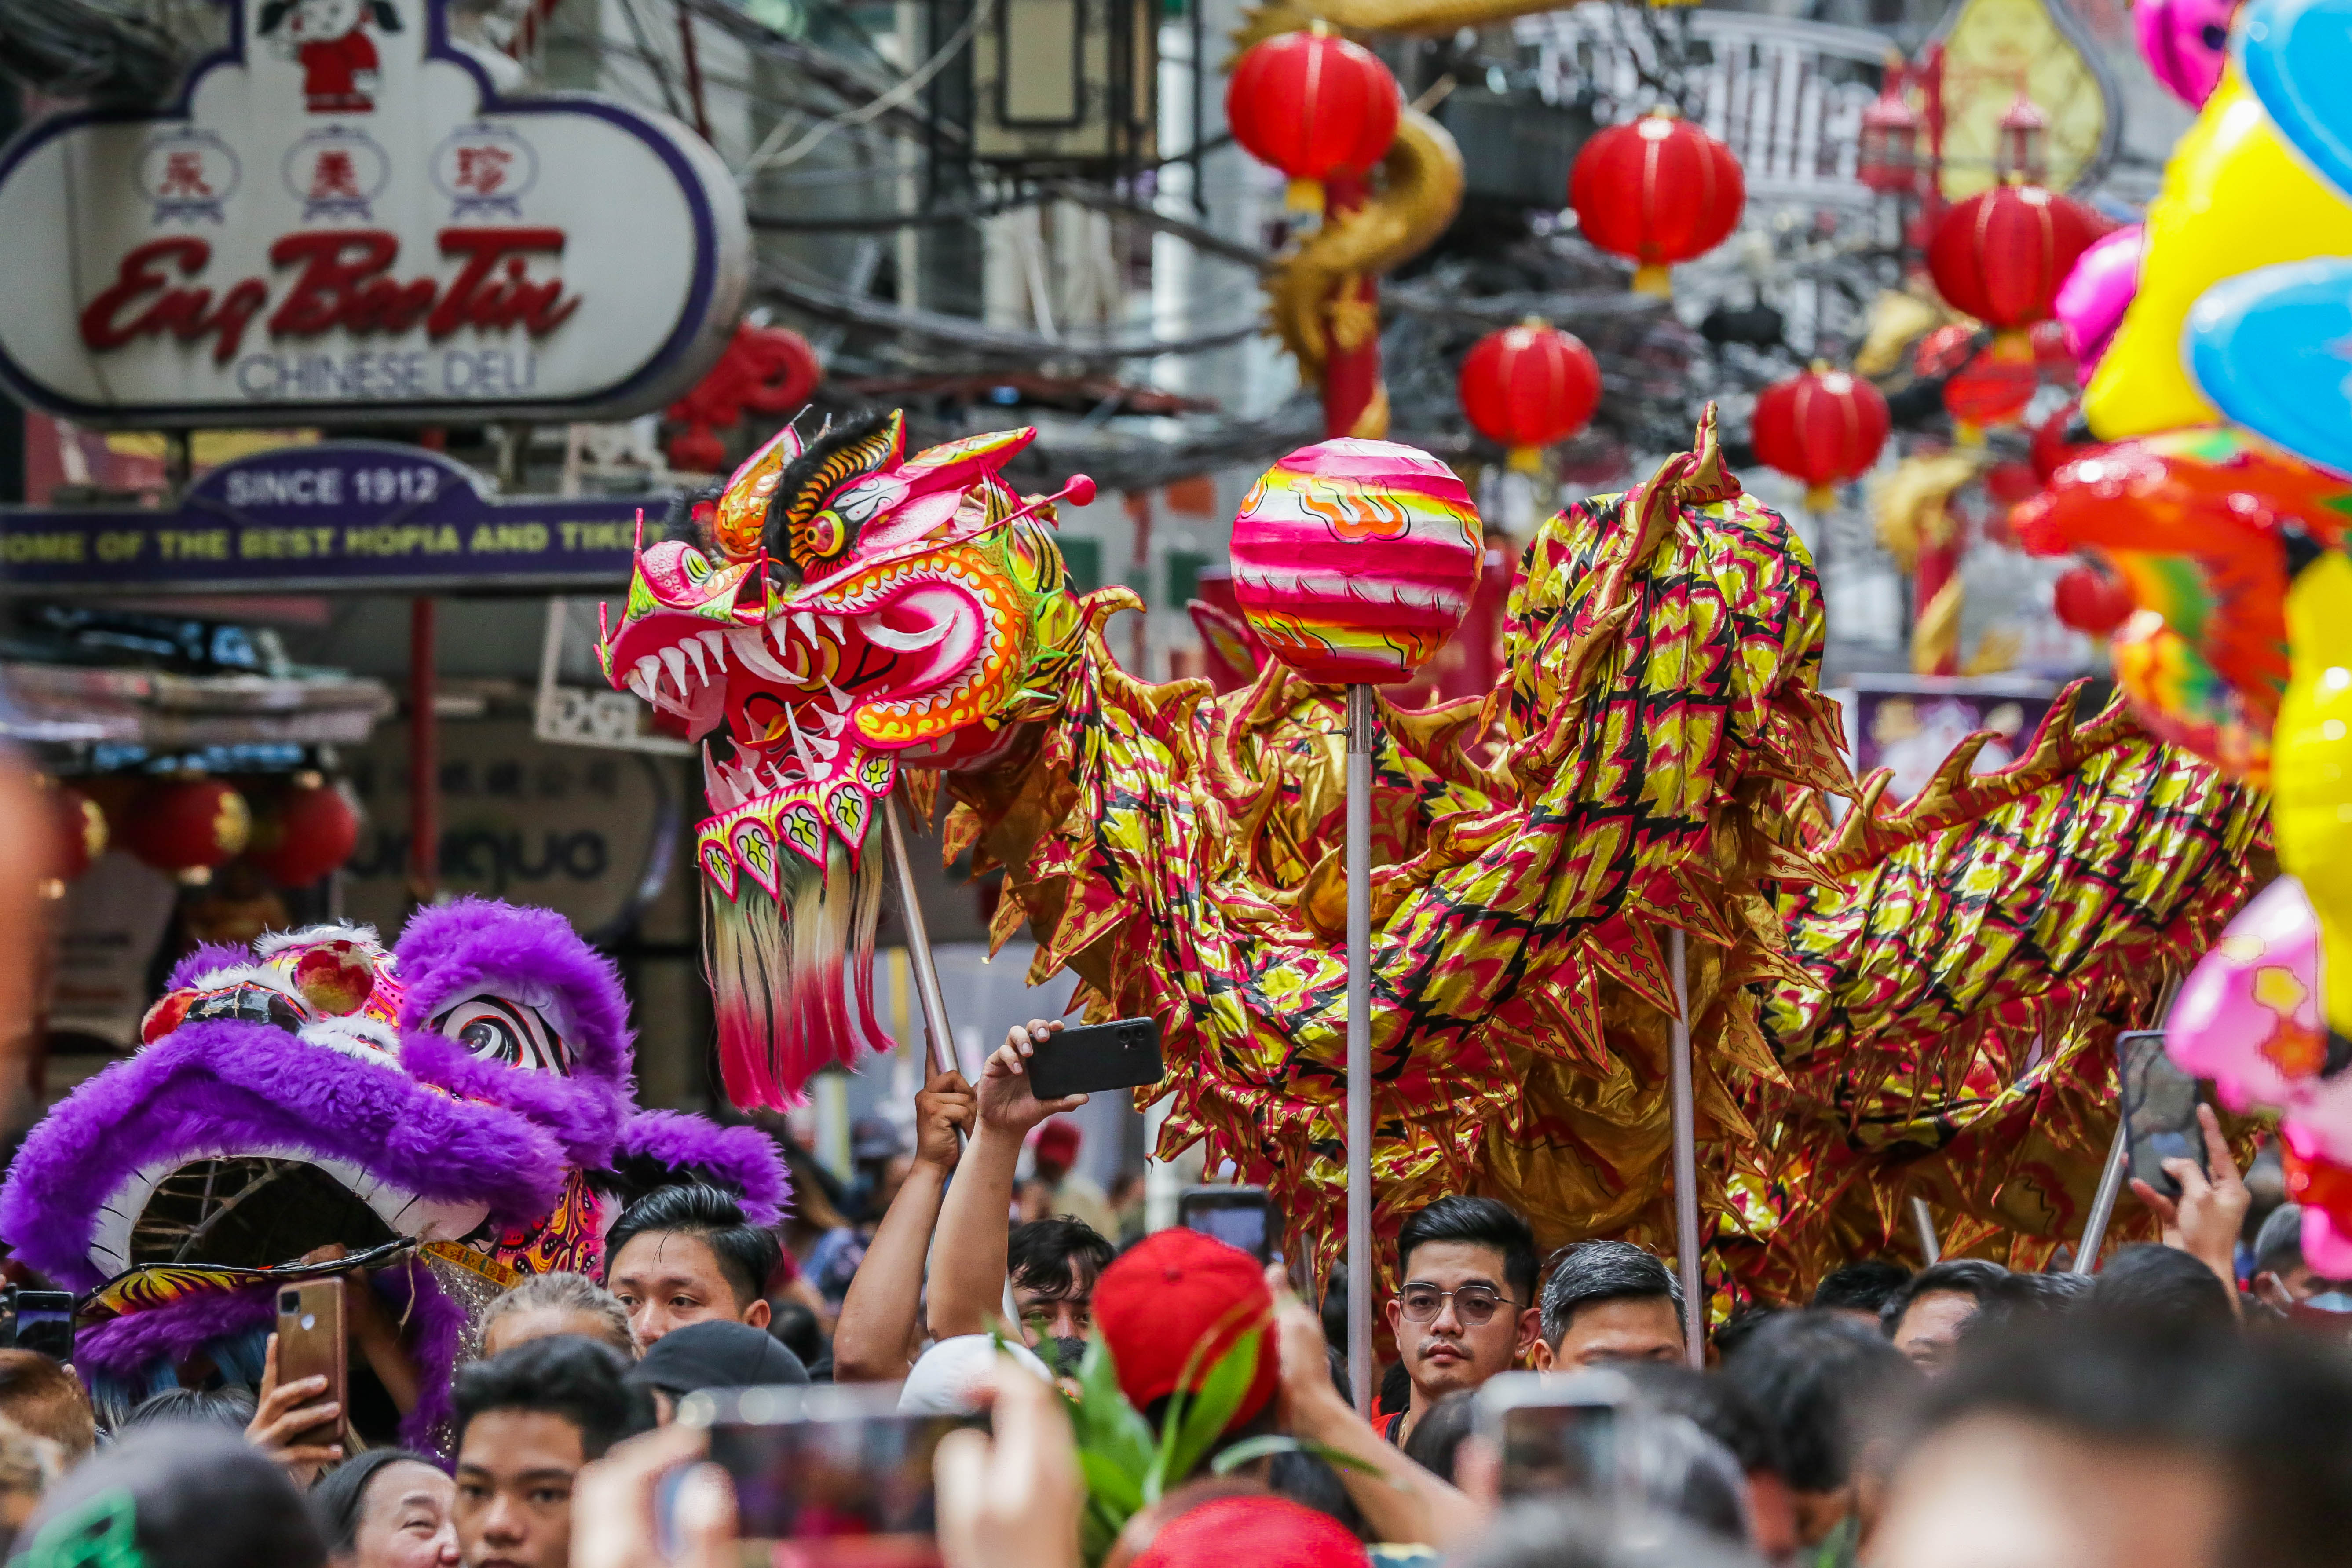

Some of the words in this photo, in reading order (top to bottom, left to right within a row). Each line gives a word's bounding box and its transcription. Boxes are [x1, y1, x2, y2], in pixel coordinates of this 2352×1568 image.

[81, 235, 269, 366] Eng
[269, 228, 438, 336] Bee
[428, 226, 582, 340] Tin
[237, 352, 428, 401] CHINESE
[443, 348, 535, 397] DELI
[226, 468, 344, 507] SINCE
[354, 466, 438, 505] 1912
[0, 531, 85, 563] OME
[95, 530, 143, 563] OF
[158, 529, 229, 561] THE
[239, 527, 336, 559] BEST
[345, 525, 461, 556] HOPIA
[469, 523, 550, 554] AND
